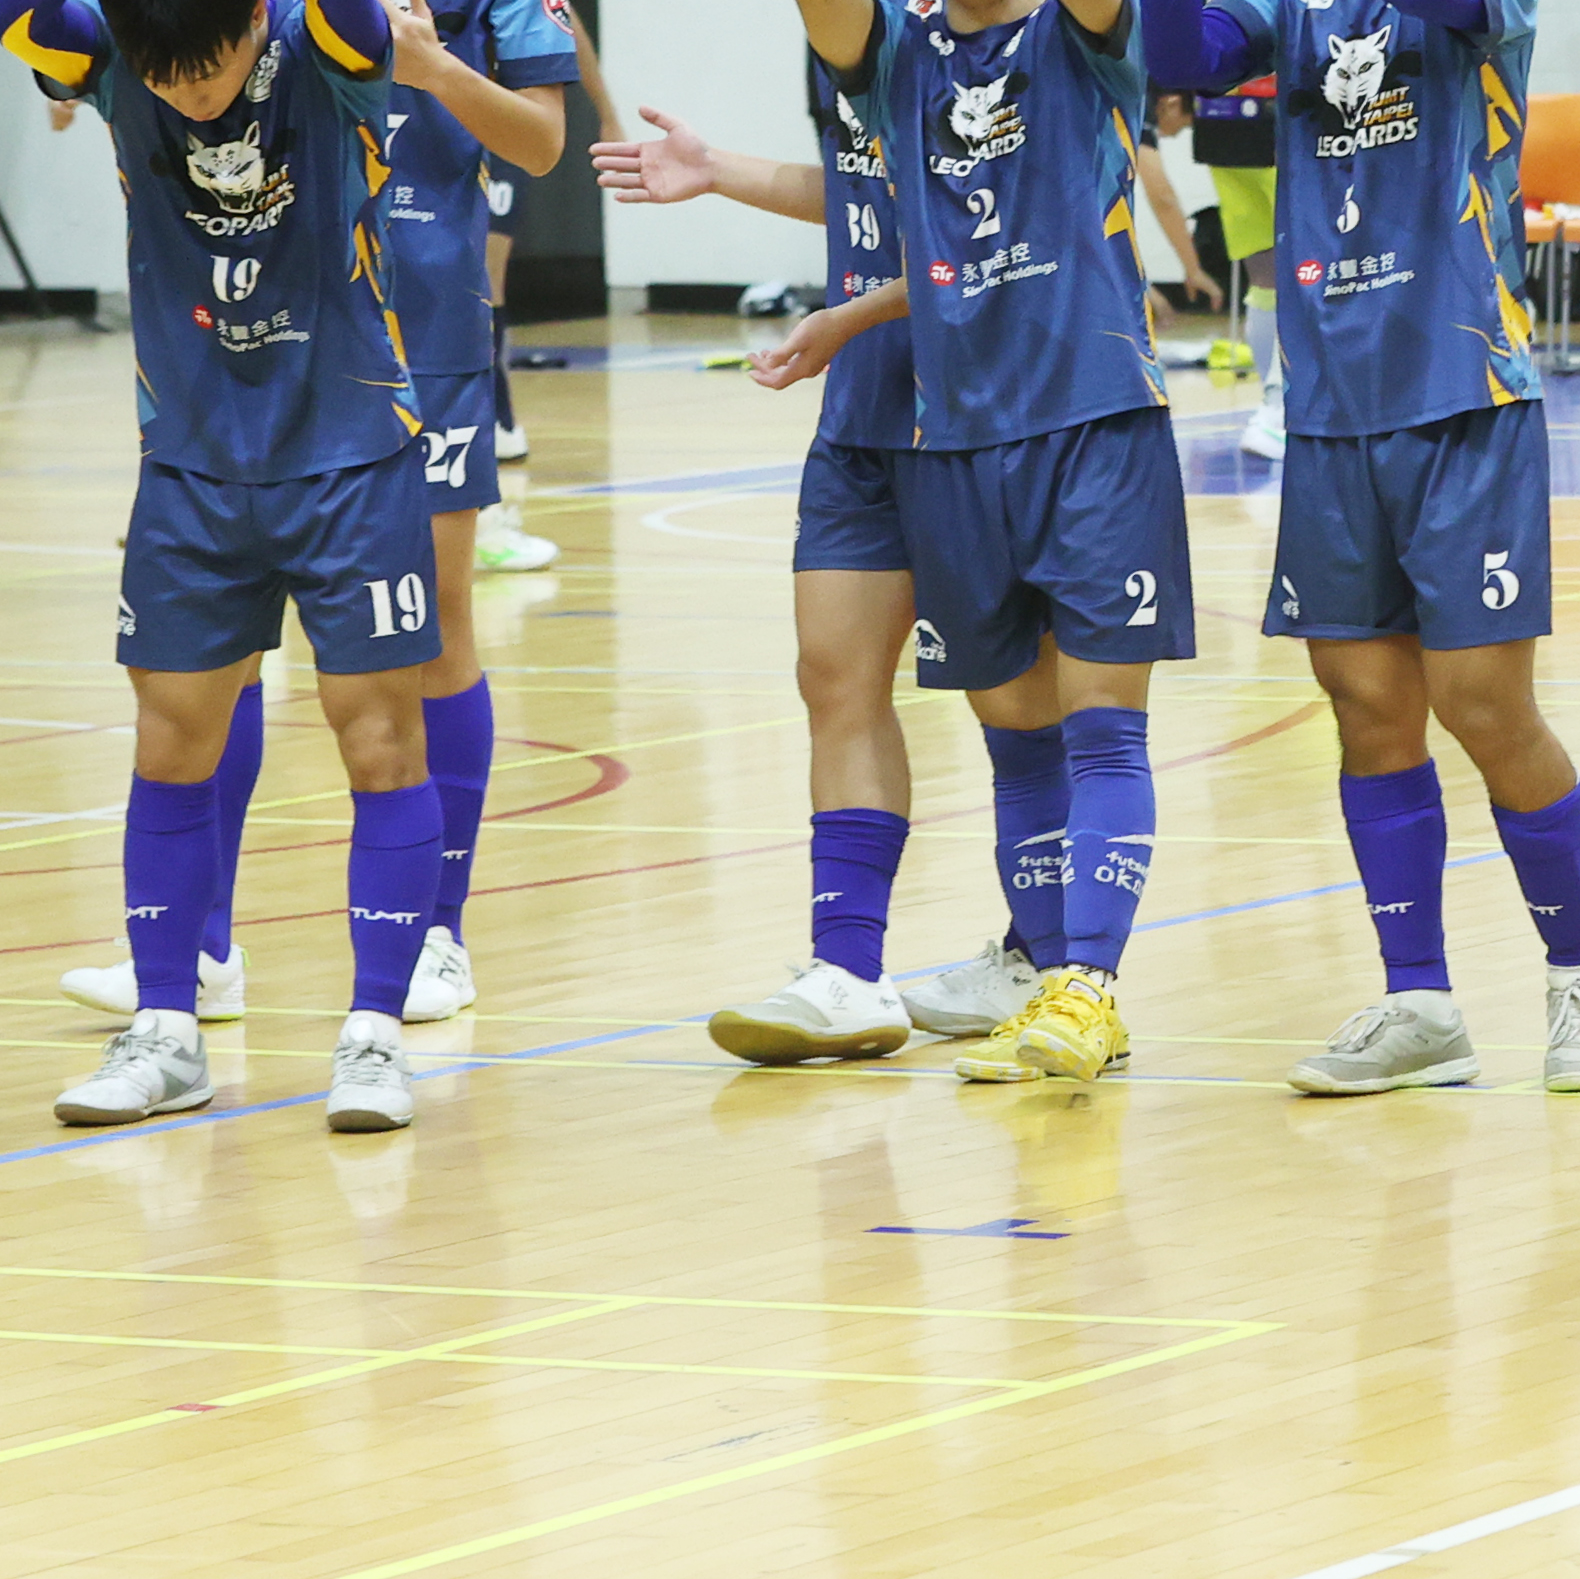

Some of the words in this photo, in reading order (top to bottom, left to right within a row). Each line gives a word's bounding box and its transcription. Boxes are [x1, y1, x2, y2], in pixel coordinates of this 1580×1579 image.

[967, 188, 1000, 239] 2
[210, 255, 262, 303] 19
[422, 425, 480, 489] 27
[364, 573, 427, 639] 19
[1125, 570, 1158, 627] 2
[1481, 550, 1520, 610] 5
[350, 906, 420, 924] TUMT
